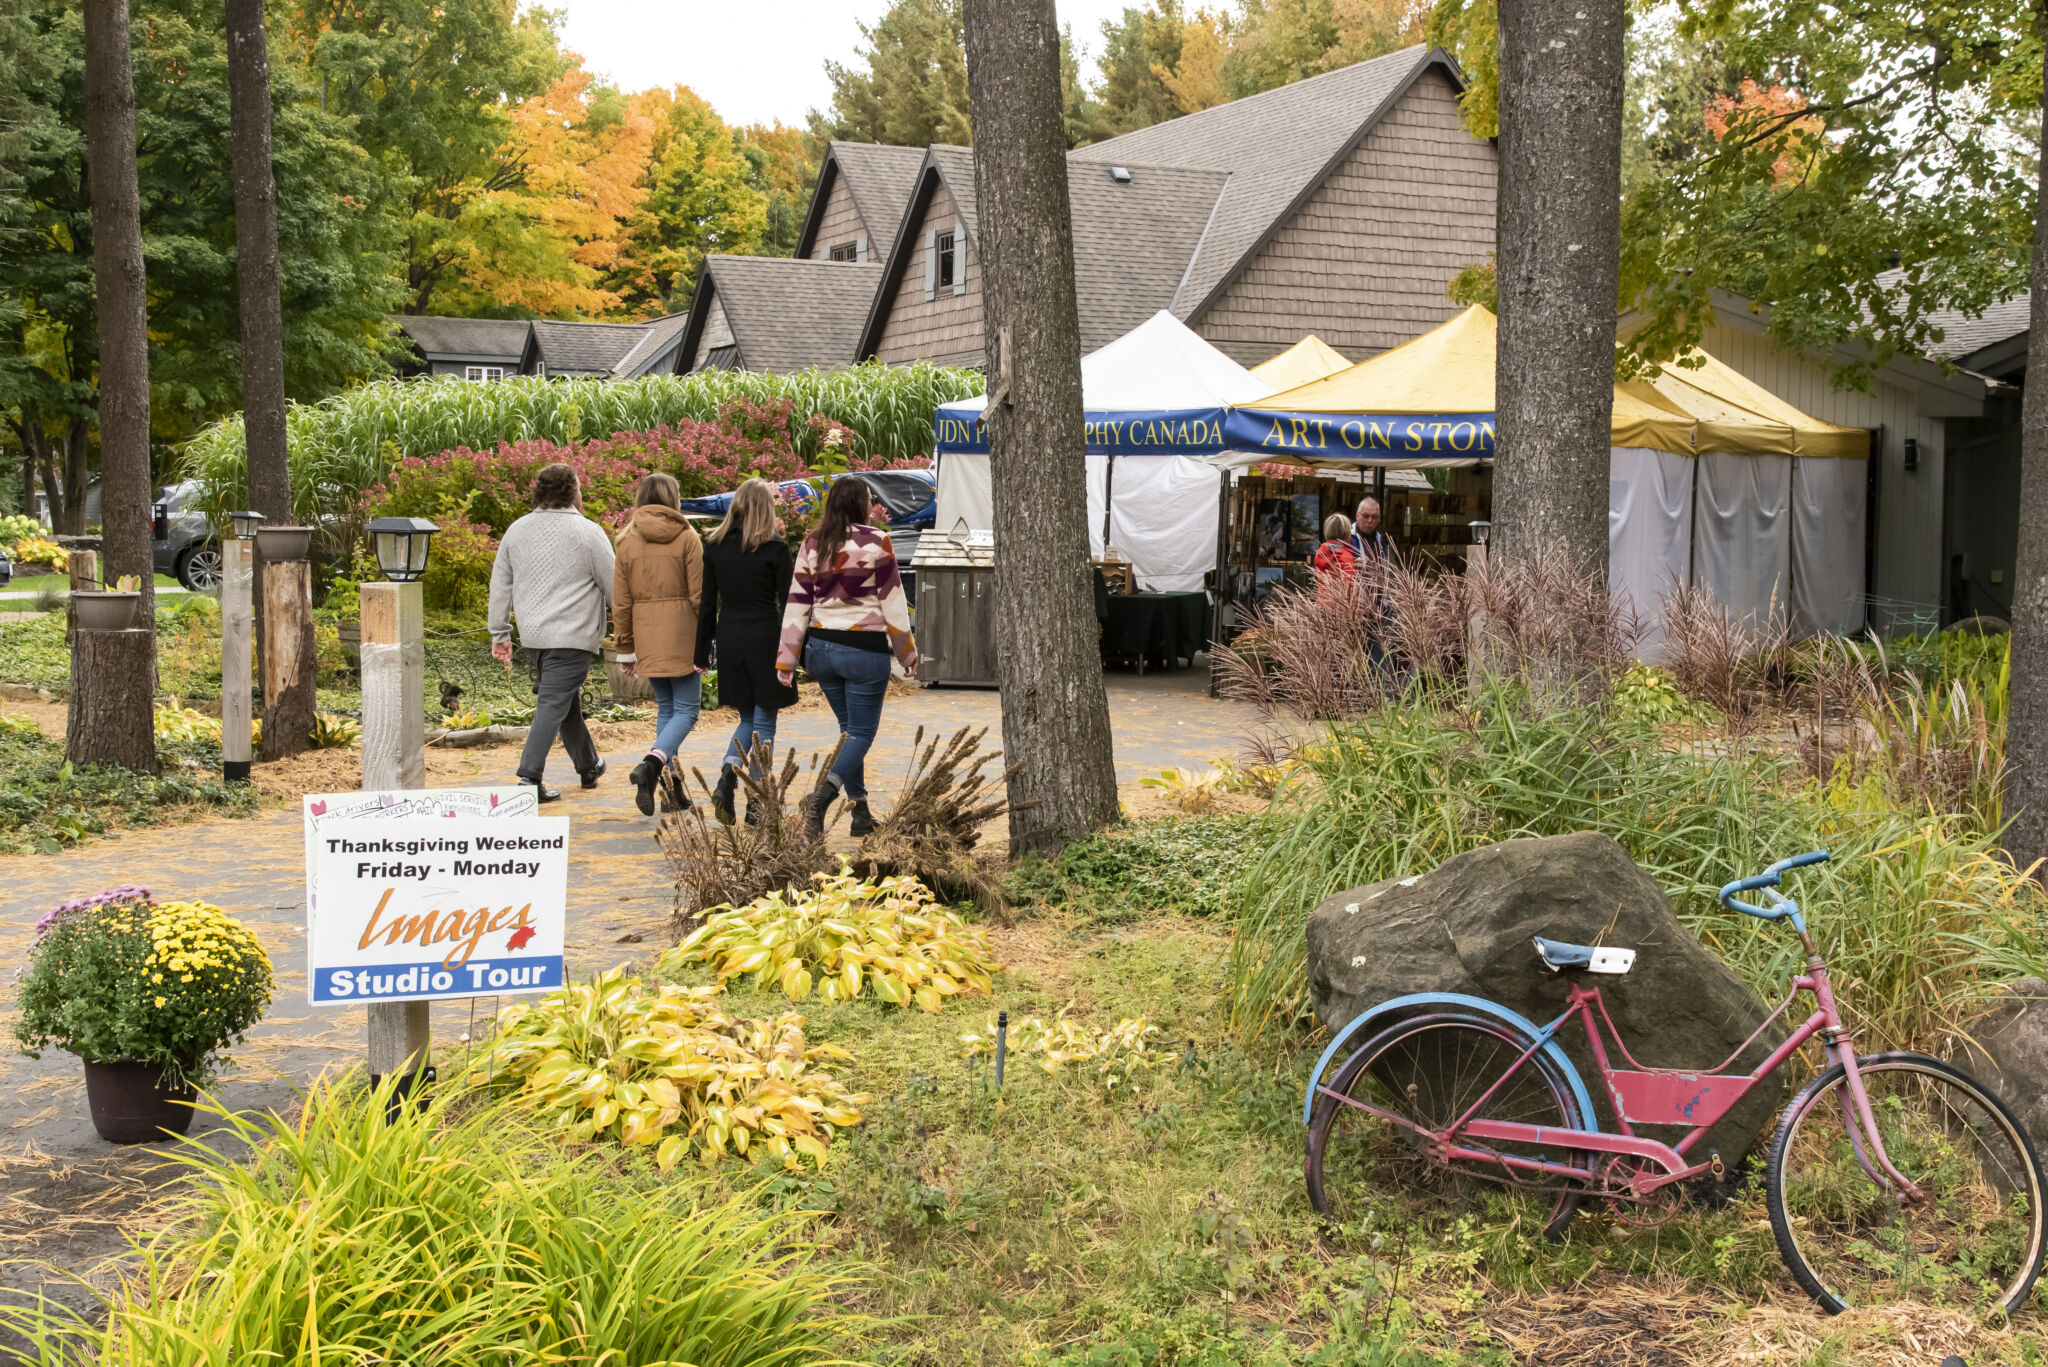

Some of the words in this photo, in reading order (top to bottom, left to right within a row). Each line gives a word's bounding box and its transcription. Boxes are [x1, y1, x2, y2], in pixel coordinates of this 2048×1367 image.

[937, 419, 970, 443] JDN
[1129, 419, 1224, 446] CANADA
[1262, 418, 1332, 448] ART
[1340, 420, 1396, 449] ON
[345, 798, 380, 814] drivers
[326, 837, 469, 855] Thanksgiving
[475, 835, 563, 851] Weekend
[356, 862, 431, 881] Friday
[453, 859, 541, 878] Monday
[358, 887, 538, 971] Images
[329, 966, 453, 997] Studio
[466, 963, 547, 989] Tour
